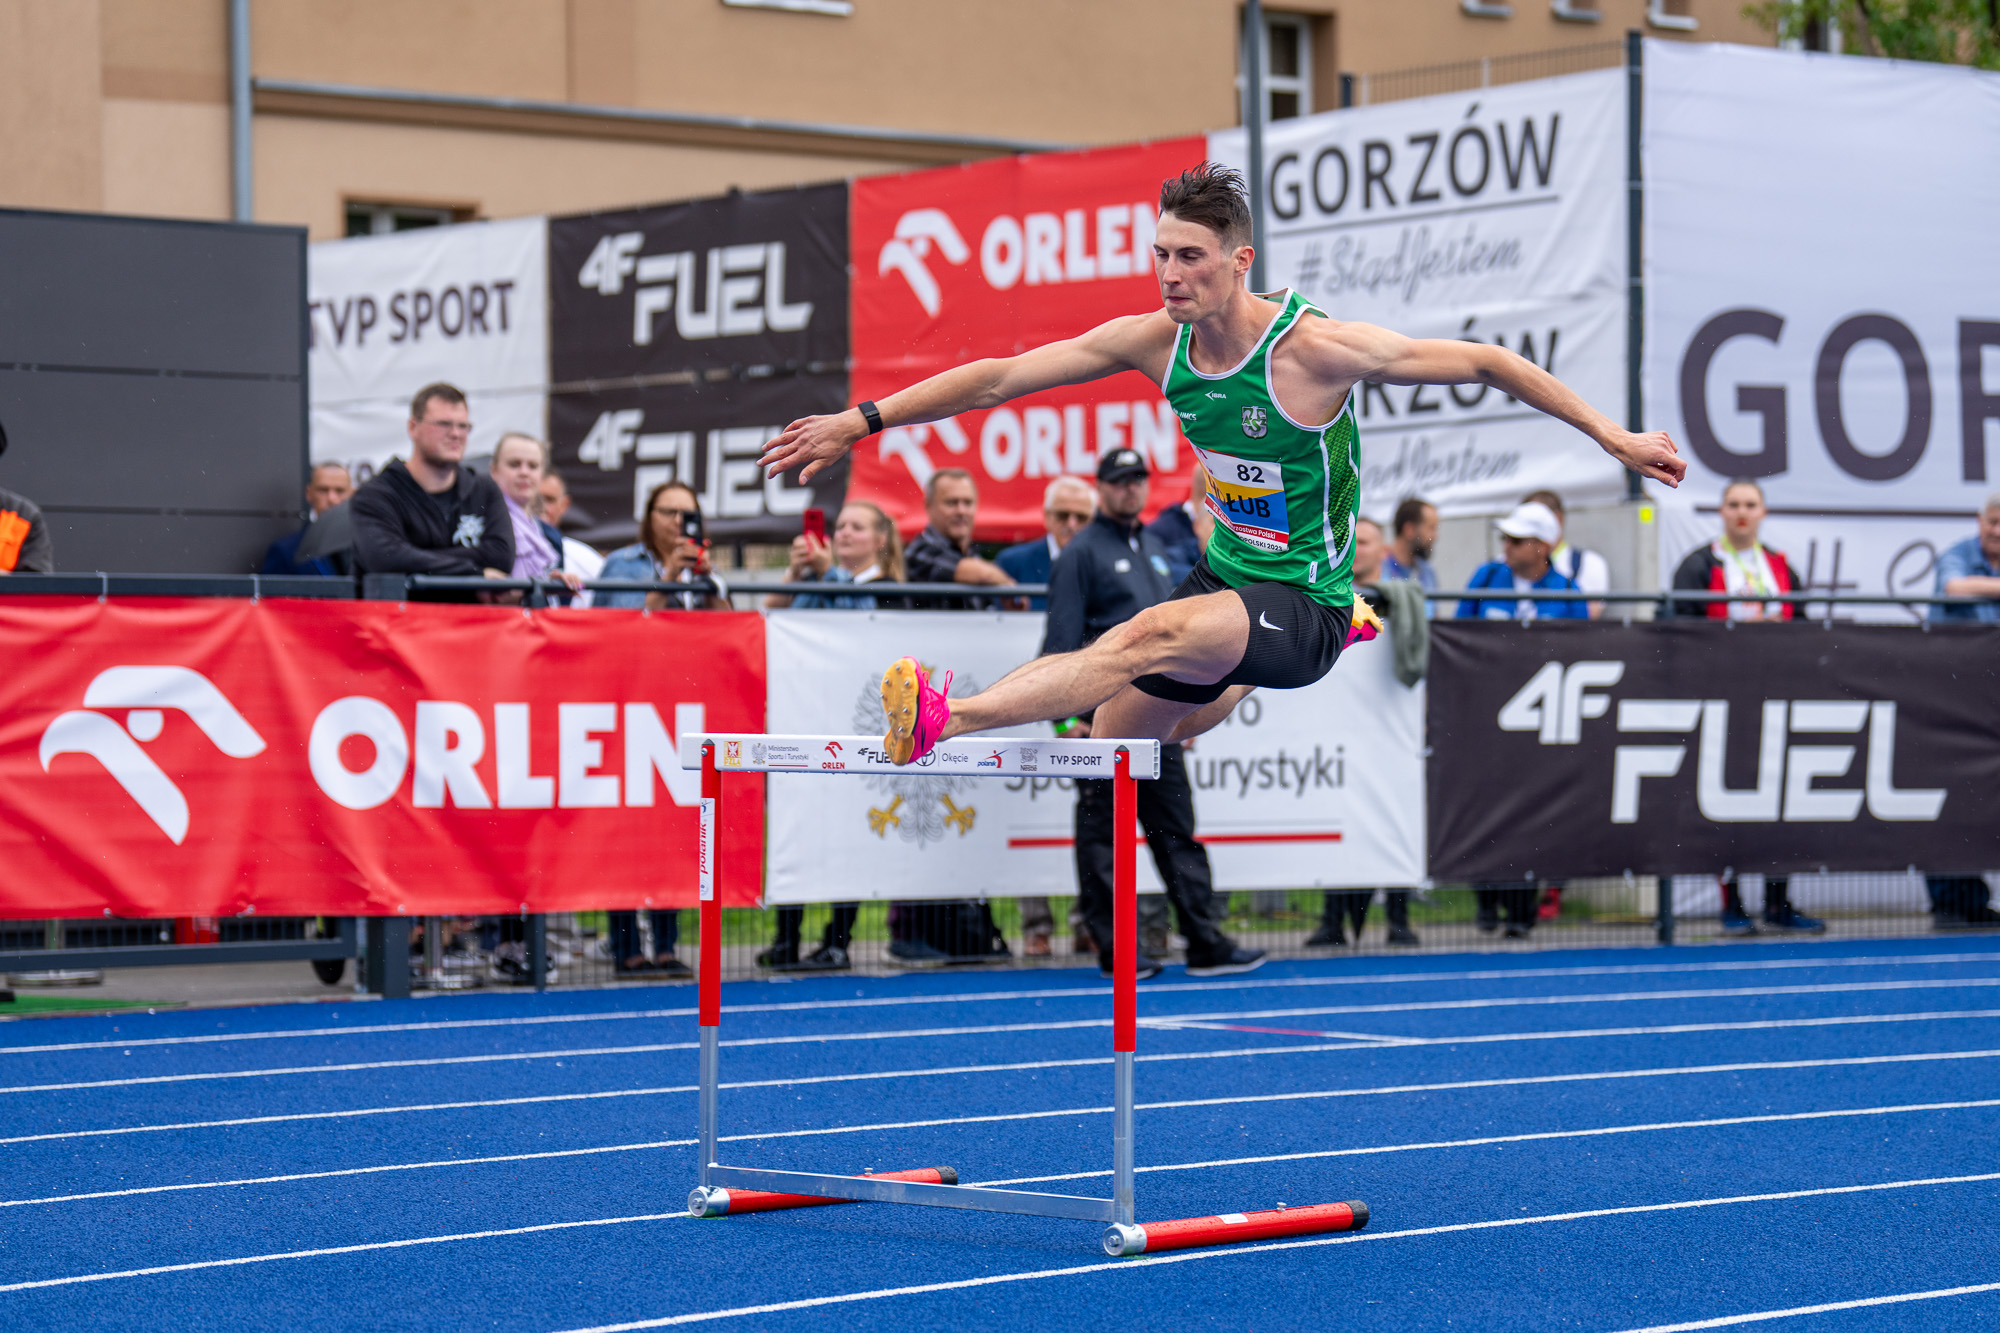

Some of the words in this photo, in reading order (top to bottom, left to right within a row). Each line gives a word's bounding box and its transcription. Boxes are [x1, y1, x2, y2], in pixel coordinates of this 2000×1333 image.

[1269, 102, 1561, 221] GORZÓW
[980, 202, 1160, 290] ORLEN
[578, 231, 645, 296] 4F
[633, 241, 815, 346] FUEL
[309, 297, 377, 351] TVP
[389, 281, 515, 344] SPORT
[578, 408, 645, 472] 4F
[980, 400, 1179, 482] ORLEN
[1236, 464, 1265, 484] 82
[1258, 528, 1276, 540] Polski
[308, 695, 706, 811] ORLEN
[822, 762, 845, 770] ORLEN
[867, 751, 895, 764] FUE
[941, 752, 969, 764] Okęcie
[977, 759, 997, 768] polanik
[1050, 755, 1070, 765] TVP
[1071, 756, 1102, 767] SPORT
[1497, 659, 1626, 746] 4F
[1611, 699, 1948, 824] FUEL
[1186, 745, 1346, 798] urystyki
[700, 823, 709, 875] polanik
